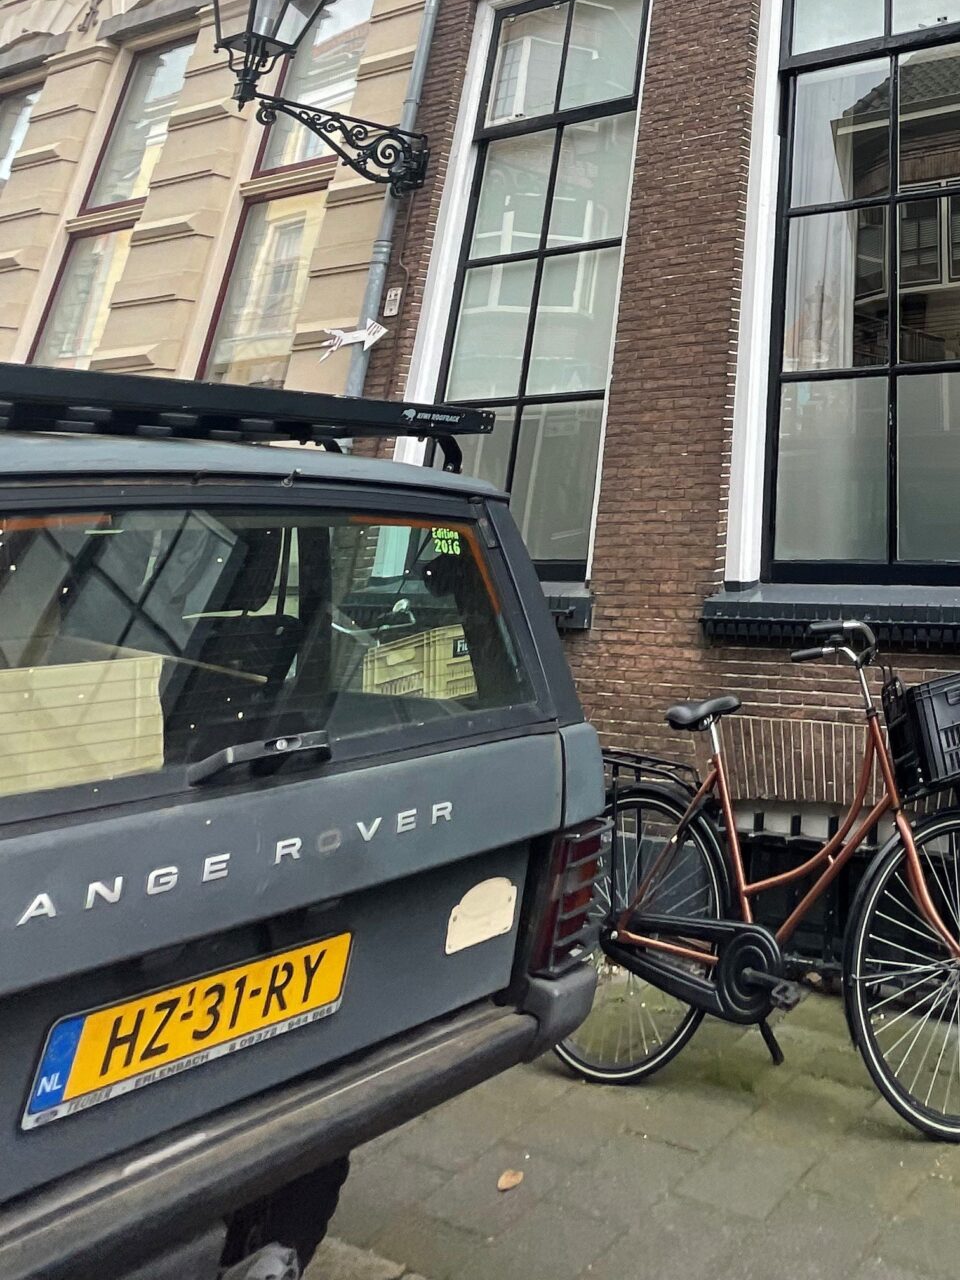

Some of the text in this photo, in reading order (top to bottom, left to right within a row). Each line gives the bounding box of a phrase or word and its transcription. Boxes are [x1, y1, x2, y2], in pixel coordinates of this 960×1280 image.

[431, 527, 459, 540] Edition
[434, 539, 461, 555] 2016
[274, 801, 453, 865] ROVER
[36, 1071, 63, 1097] NL
